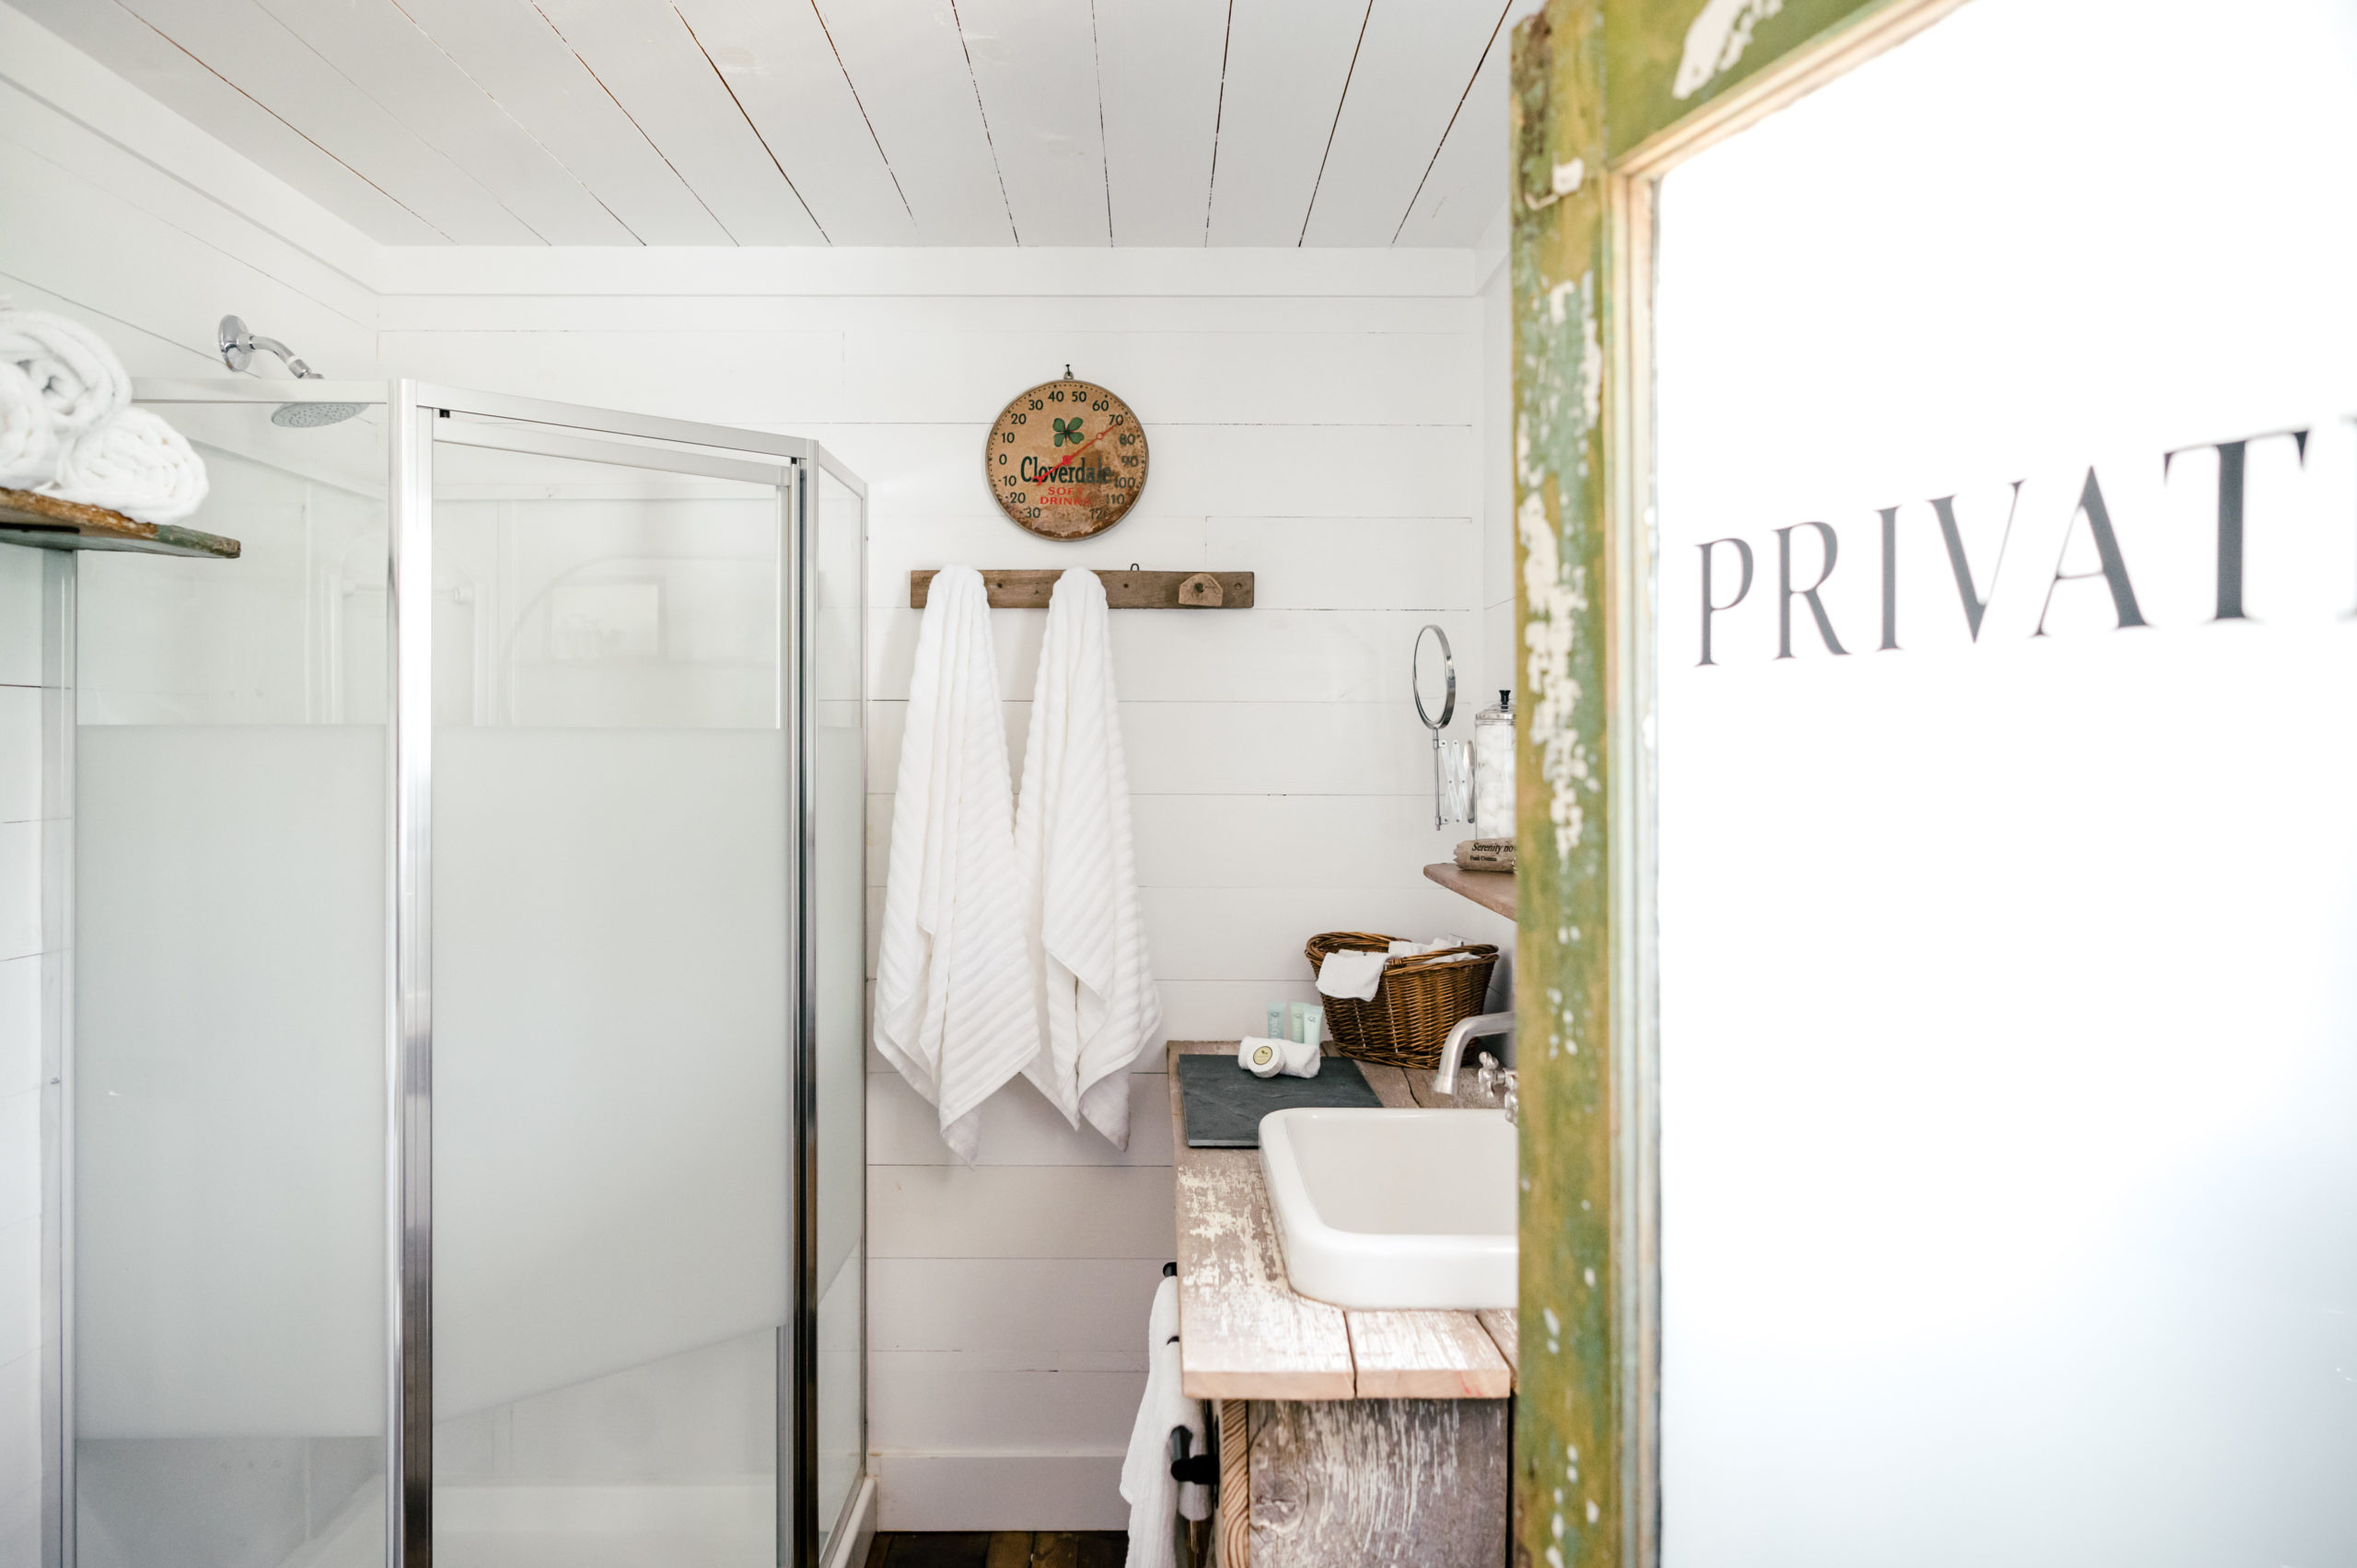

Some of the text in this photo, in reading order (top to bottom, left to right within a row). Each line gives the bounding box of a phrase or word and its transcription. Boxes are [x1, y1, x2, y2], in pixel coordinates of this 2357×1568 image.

[1048, 391, 1064, 402] 40
[1072, 391, 1086, 402] 50
[1028, 400, 1043, 411] 30
[1092, 400, 1109, 412] 60
[1011, 413, 1027, 424] 20
[1109, 414, 1124, 425] 70
[1002, 432, 1015, 443] 10
[1120, 434, 1135, 445] 80
[999, 454, 1007, 465] 0
[1121, 456, 1138, 467] 90
[1020, 456, 1112, 483] Cloverdale
[1113, 477, 1135, 488] 100
[1048, 486, 1084, 495] SOFT
[1105, 494, 1124, 505] 110
[1694, 411, 2357, 668] PRIVAT
[1471, 842, 1516, 854] Serenity no
